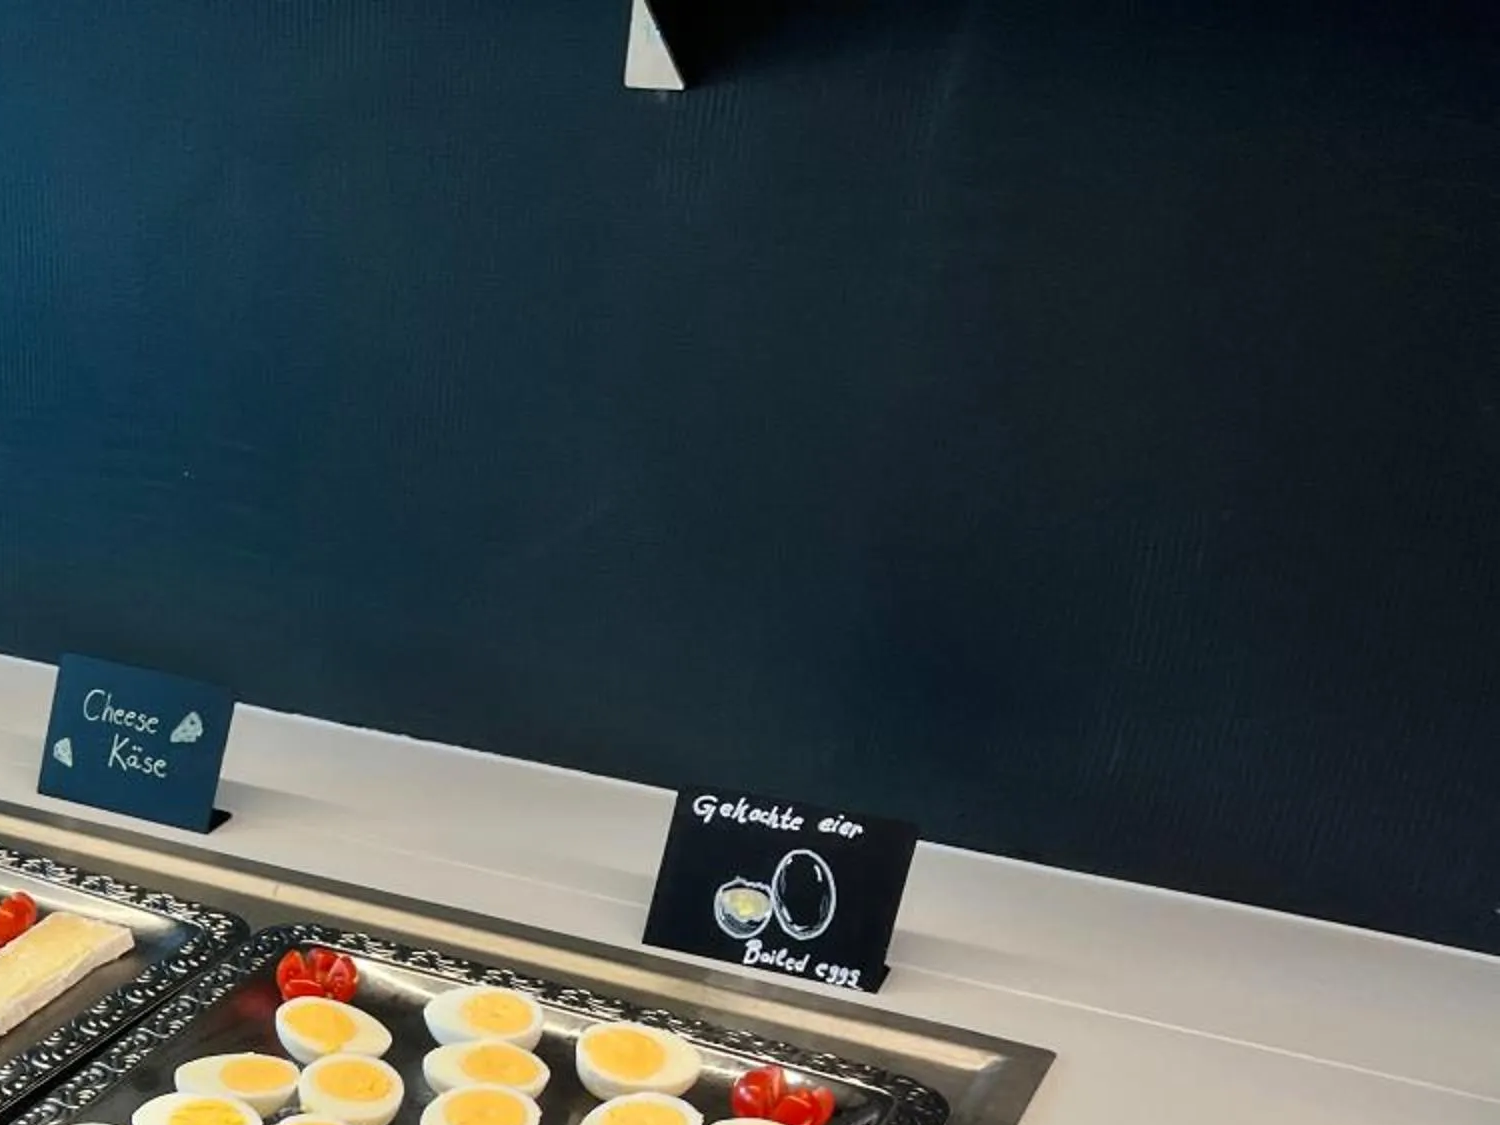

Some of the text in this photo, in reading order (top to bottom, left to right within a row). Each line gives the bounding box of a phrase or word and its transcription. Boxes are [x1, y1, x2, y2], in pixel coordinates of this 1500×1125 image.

[83, 689, 160, 734] Cheese
[107, 733, 168, 778] Käse
[693, 794, 864, 839] Gekochte eier
[743, 939, 862, 990] Boiled eggs
